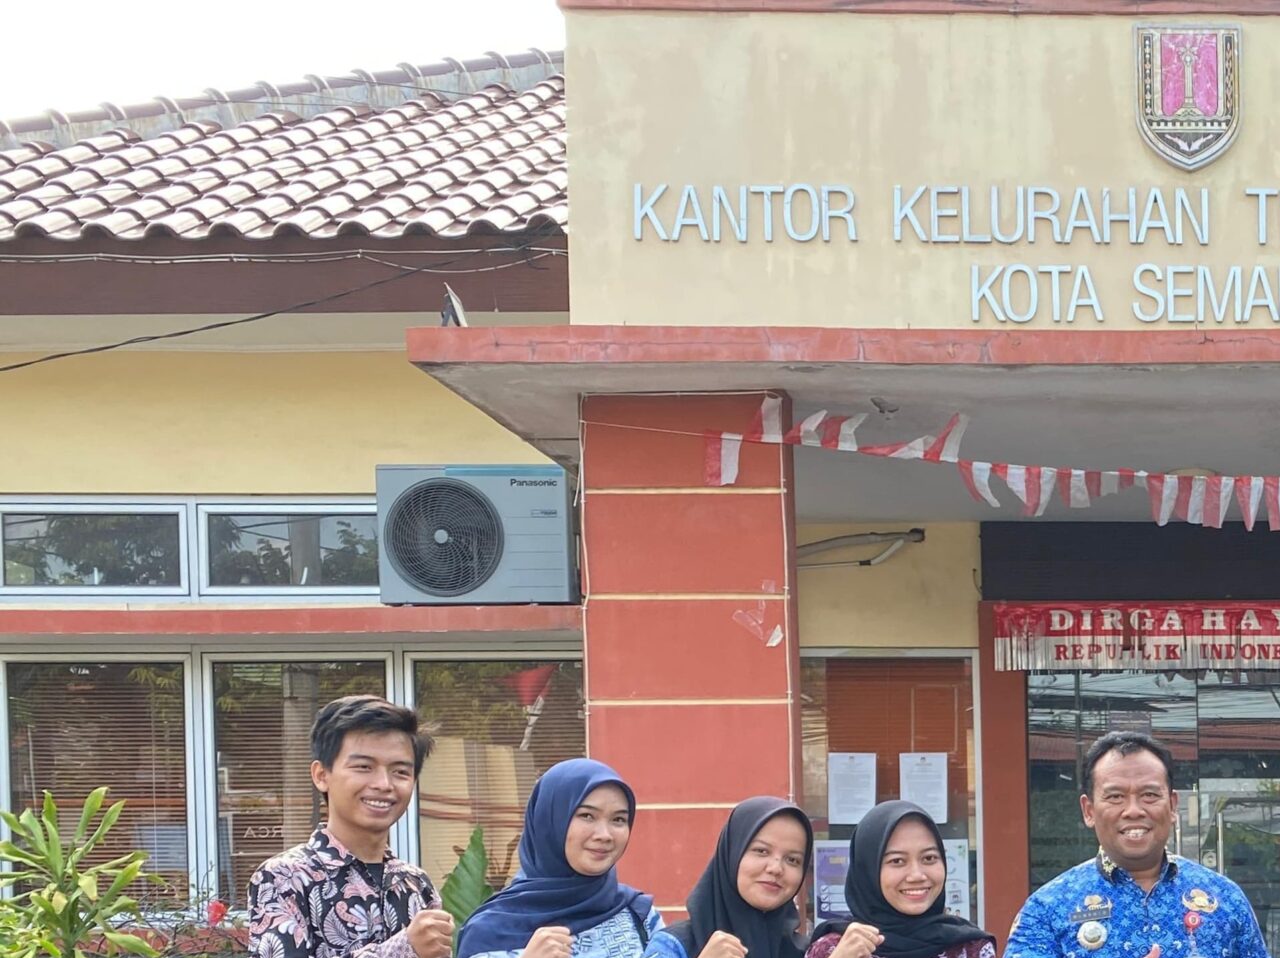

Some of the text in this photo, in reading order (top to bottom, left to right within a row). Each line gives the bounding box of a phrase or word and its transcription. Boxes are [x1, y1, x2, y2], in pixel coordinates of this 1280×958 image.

[633, 183, 858, 242] KANTOR
[893, 184, 1210, 245] KELURAHAN
[971, 263, 1104, 323] KOTA
[510, 478, 558, 487] Panasonic
